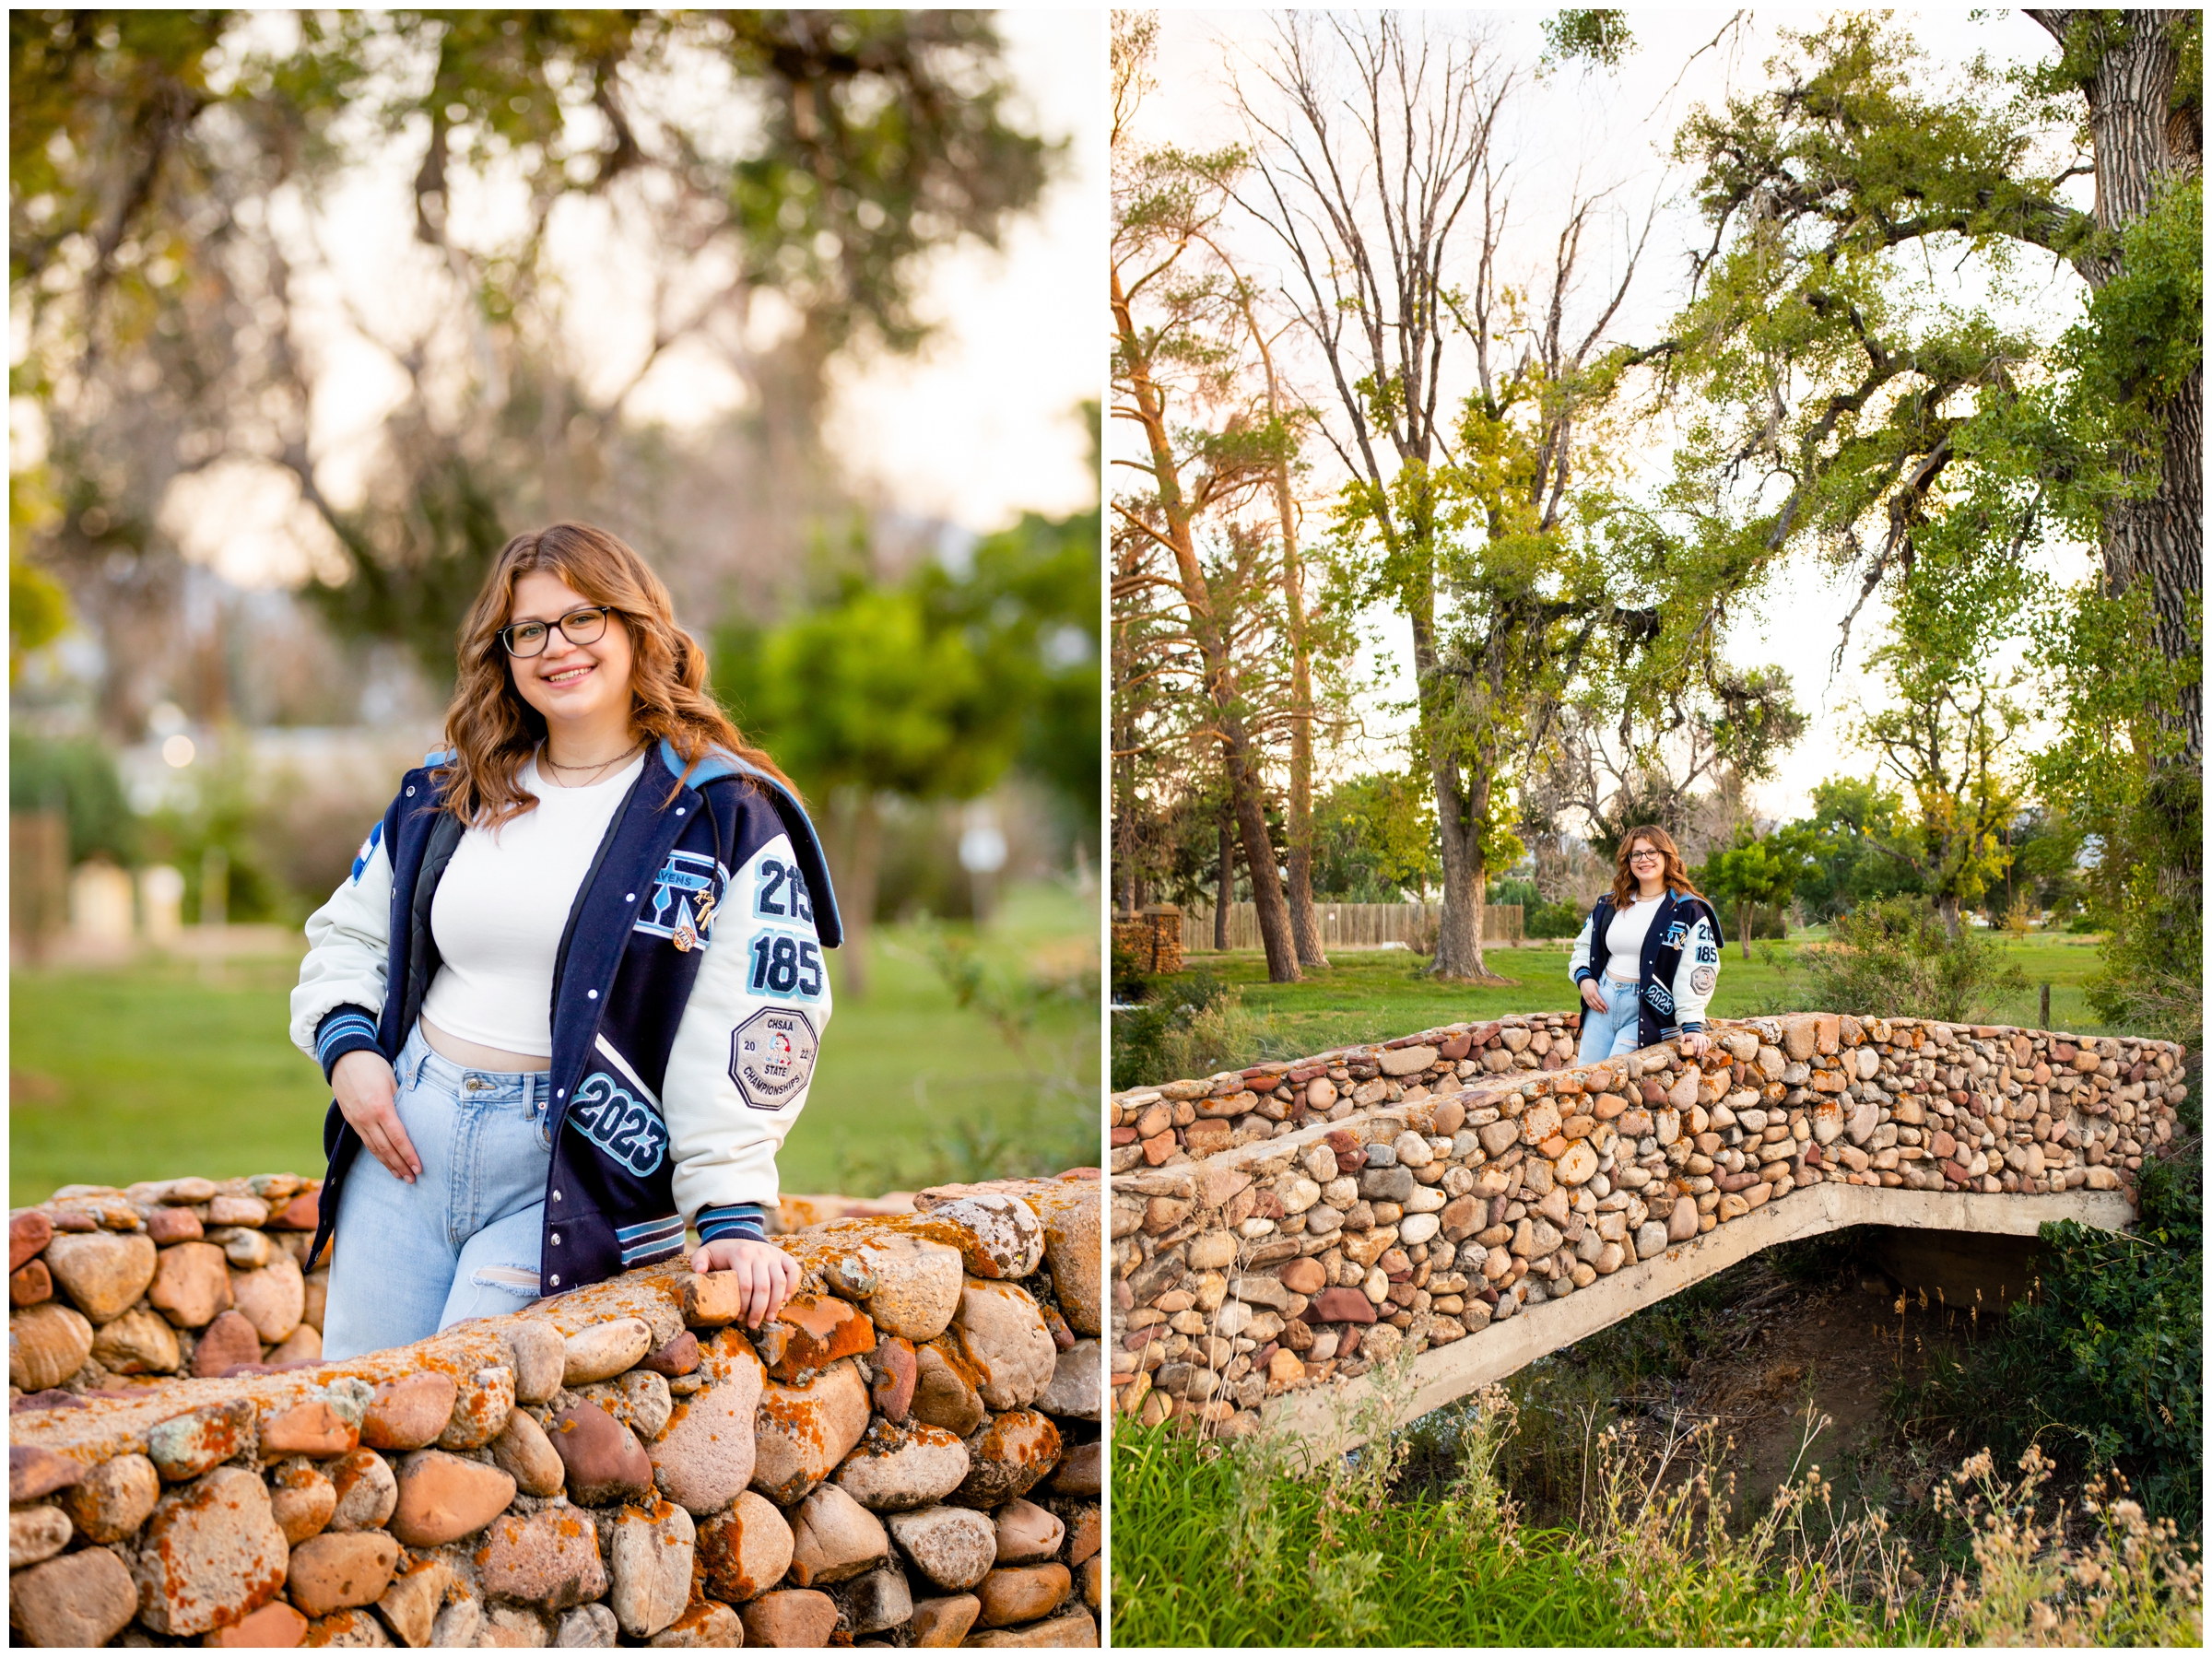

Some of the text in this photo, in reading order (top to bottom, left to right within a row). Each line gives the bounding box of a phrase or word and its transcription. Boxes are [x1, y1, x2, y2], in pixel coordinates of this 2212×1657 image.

[759, 859, 813, 923] 215
[753, 935, 822, 996] 185
[1698, 946, 1717, 963] 185
[1645, 986, 1674, 1014] 2023
[767, 1019, 794, 1031] CHSAA
[744, 1040, 809, 1060] 20 22
[743, 1066, 800, 1096] CHAMPIONSHIPS
[764, 1064, 787, 1076] STATE
[568, 1078, 666, 1172] 2023
